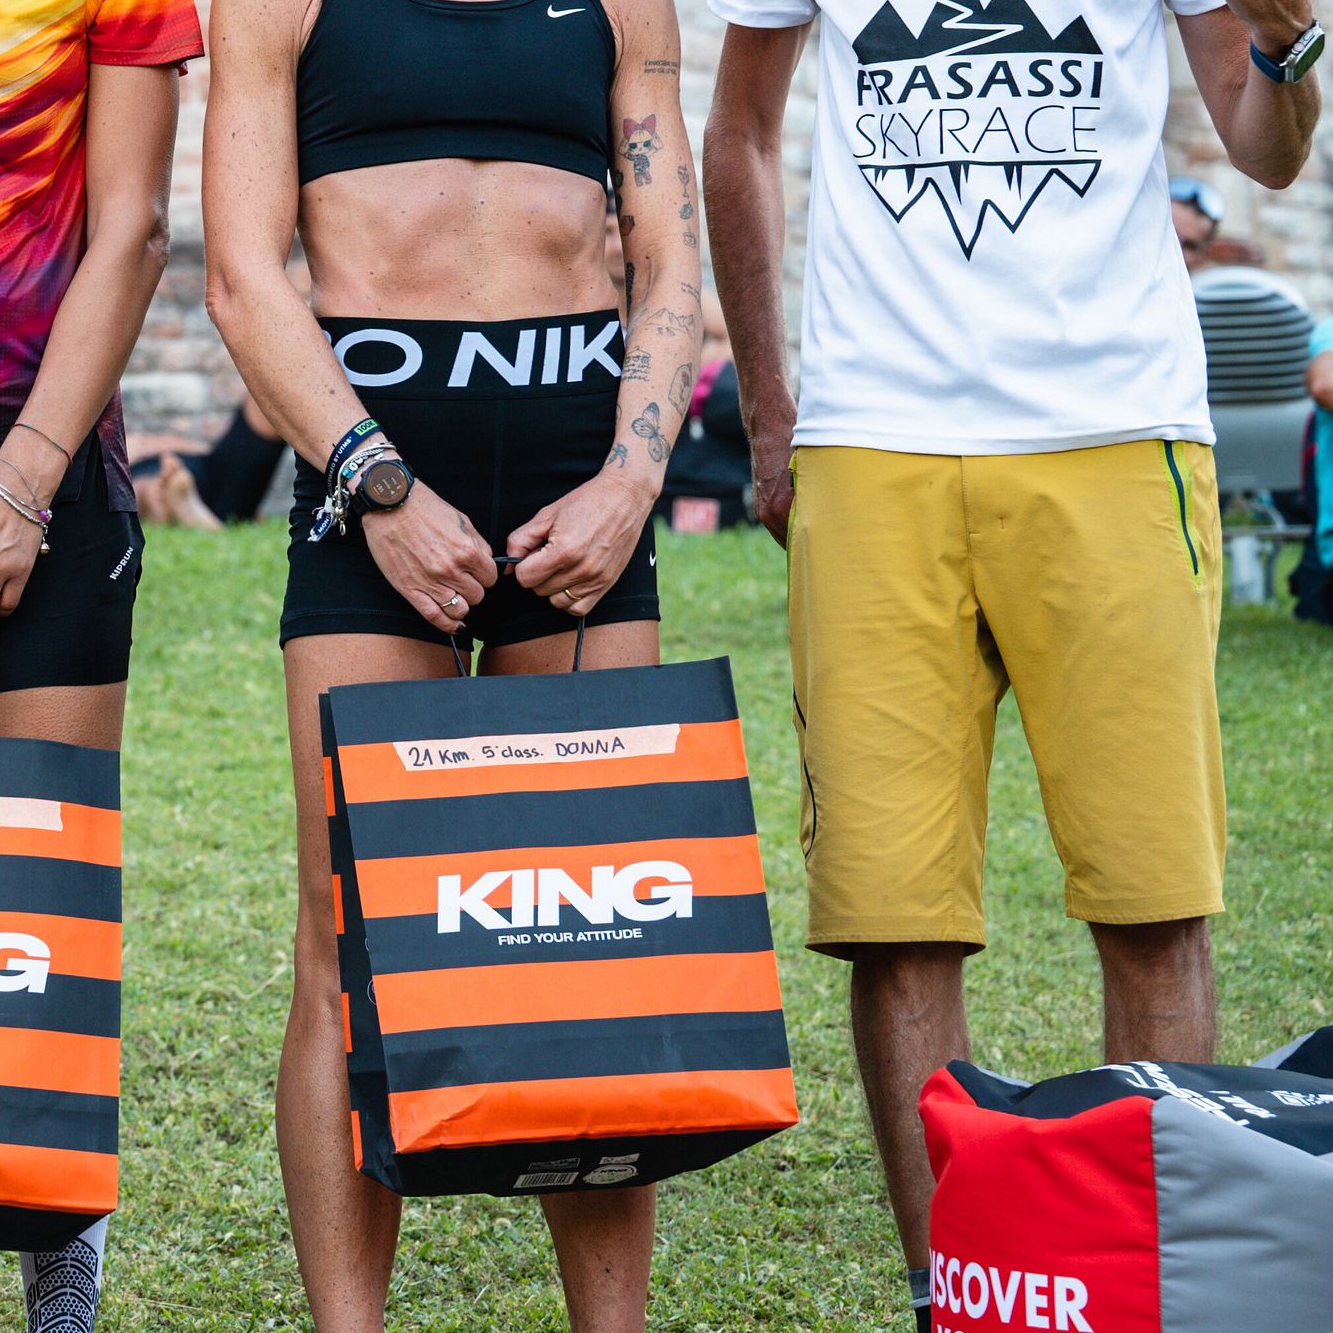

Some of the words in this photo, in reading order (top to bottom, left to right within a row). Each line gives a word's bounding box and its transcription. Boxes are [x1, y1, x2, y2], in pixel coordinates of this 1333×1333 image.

[857, 59, 1104, 106] FRASASSI
[852, 105, 1101, 159] SKYRACE
[322, 328, 423, 387] O
[357, 419, 376, 433] 100K
[109, 546, 134, 580] KIPRUN
[408, 746, 433, 767] 21
[501, 745, 544, 758] class.
[555, 736, 625, 758] DONNA
[437, 860, 693, 934] KING
[497, 934, 532, 946] FIND
[534, 931, 574, 944] YOUR
[576, 927, 643, 942] ATTITUDE
[929, 1247, 1094, 1333] ISCOVER
